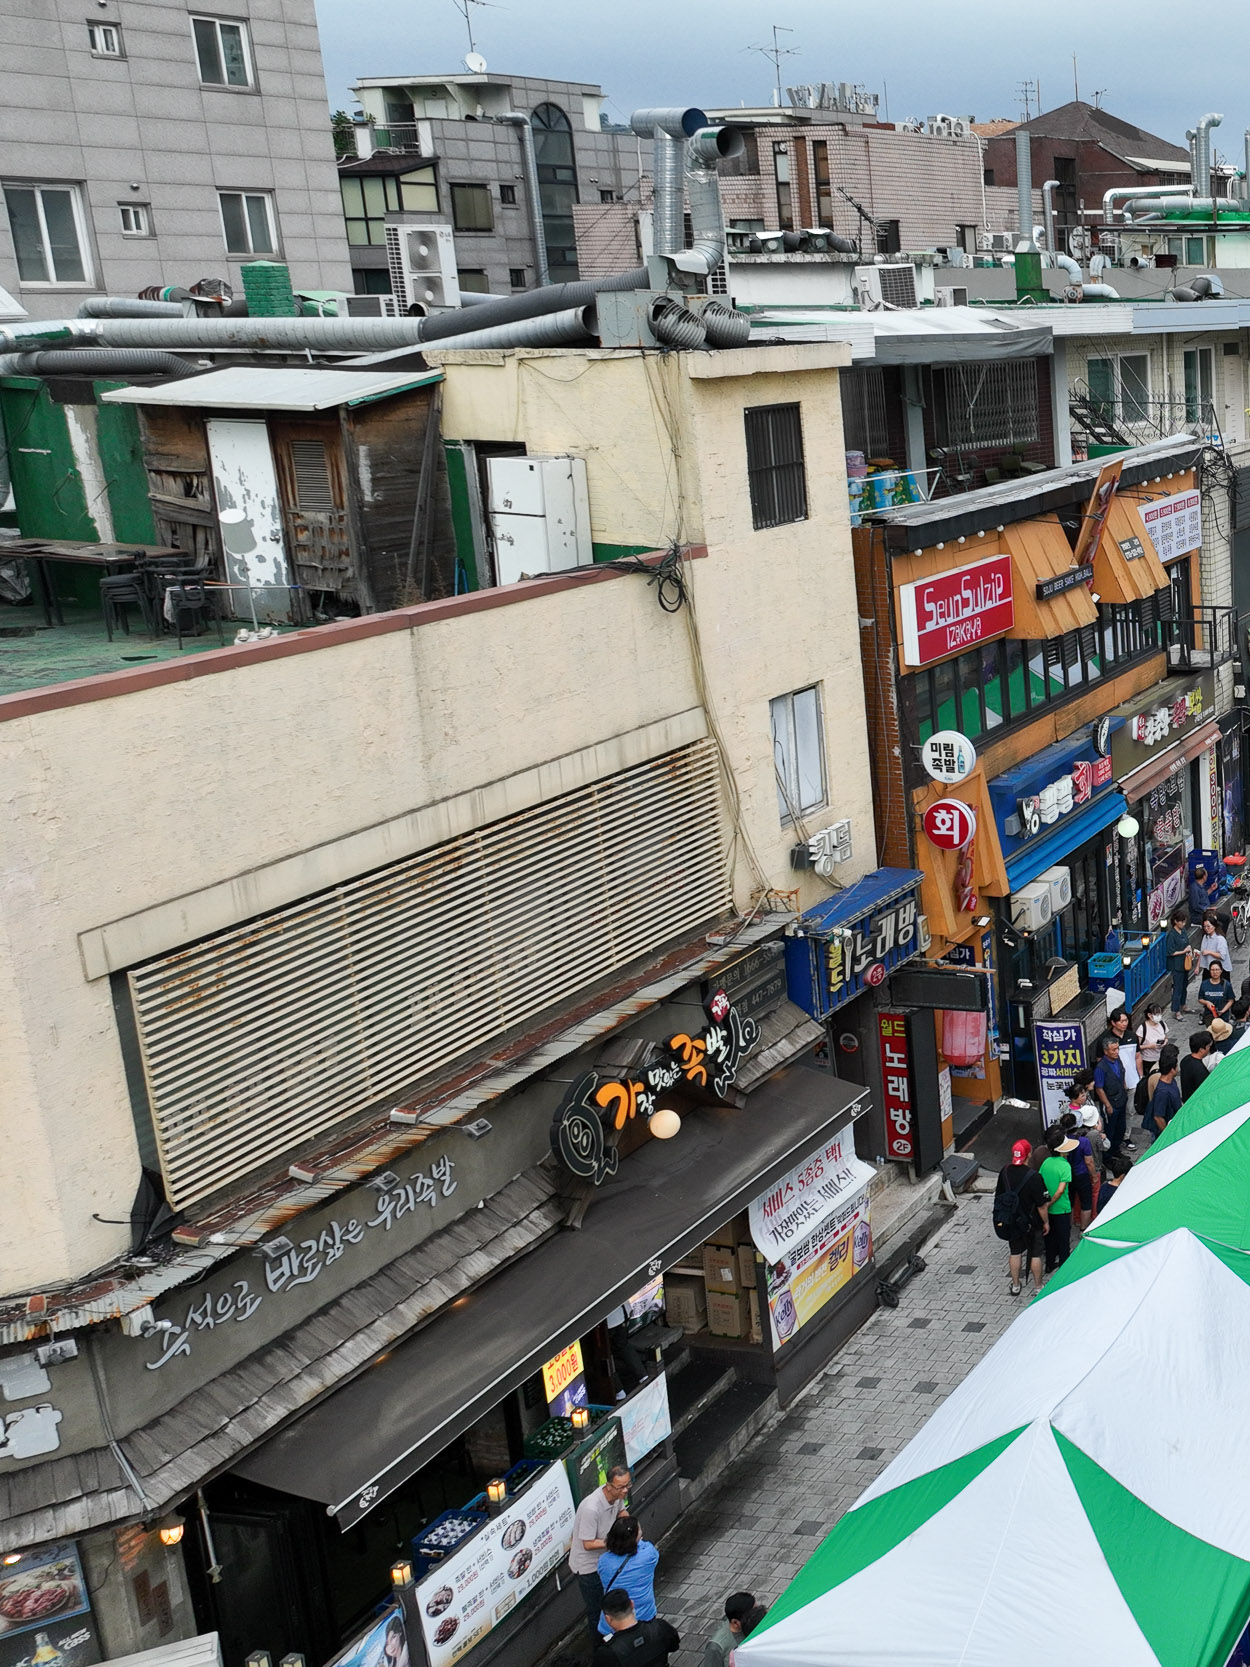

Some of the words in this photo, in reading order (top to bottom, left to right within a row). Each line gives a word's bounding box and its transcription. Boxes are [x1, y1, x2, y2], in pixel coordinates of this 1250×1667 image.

[1054, 580, 1064, 592] BEER
[1065, 577, 1075, 588] SAKE
[930, 742, 955, 757] 미림
[931, 758, 957, 774] 족발
[932, 808, 960, 845] 회
[854, 899, 917, 973] 노래방
[881, 1019, 906, 1037] 월드
[1042, 1029, 1077, 1042] 작심가
[648, 1061, 681, 1091] 맛있는
[670, 1026, 728, 1087] 족발
[1040, 1049, 1082, 1066] 3가지
[885, 1043, 912, 1135] 노래방
[896, 1141, 909, 1151] 2F
[367, 1155, 456, 1231] 우리족발
[762, 1182, 796, 1222] 서비스
[825, 1142, 842, 1163] 택1
[768, 1198, 824, 1247] 가장맛있는
[828, 1236, 850, 1272] 켈리
[774, 1299, 793, 1324] Kelly
[548, 1351, 579, 1393] 3,000원
[63, 1630, 91, 1651] Cass
